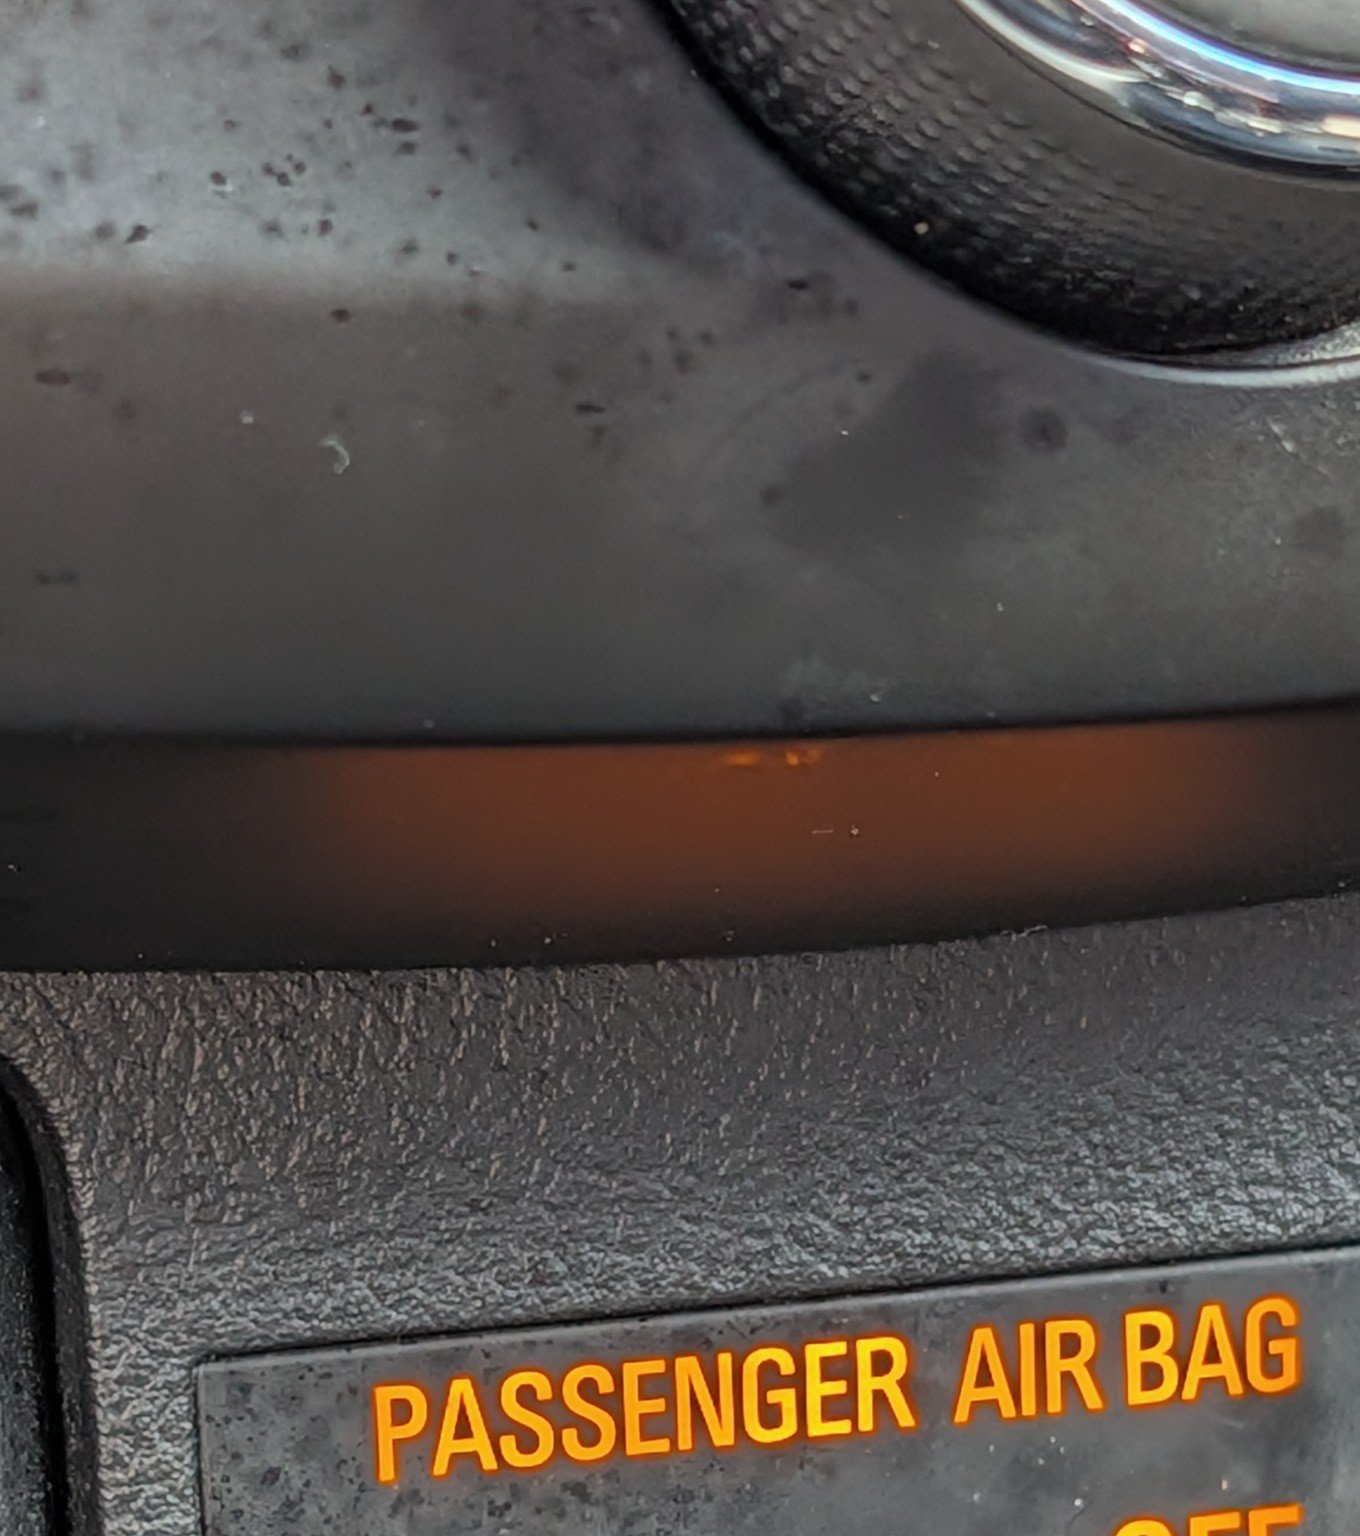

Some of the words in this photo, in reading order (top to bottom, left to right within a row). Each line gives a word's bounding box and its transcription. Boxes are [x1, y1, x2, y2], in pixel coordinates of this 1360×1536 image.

[371, 1333, 921, 1487] PASSENGER
[952, 1309, 1108, 1428] AIR
[1122, 1293, 1303, 1412] BAG
